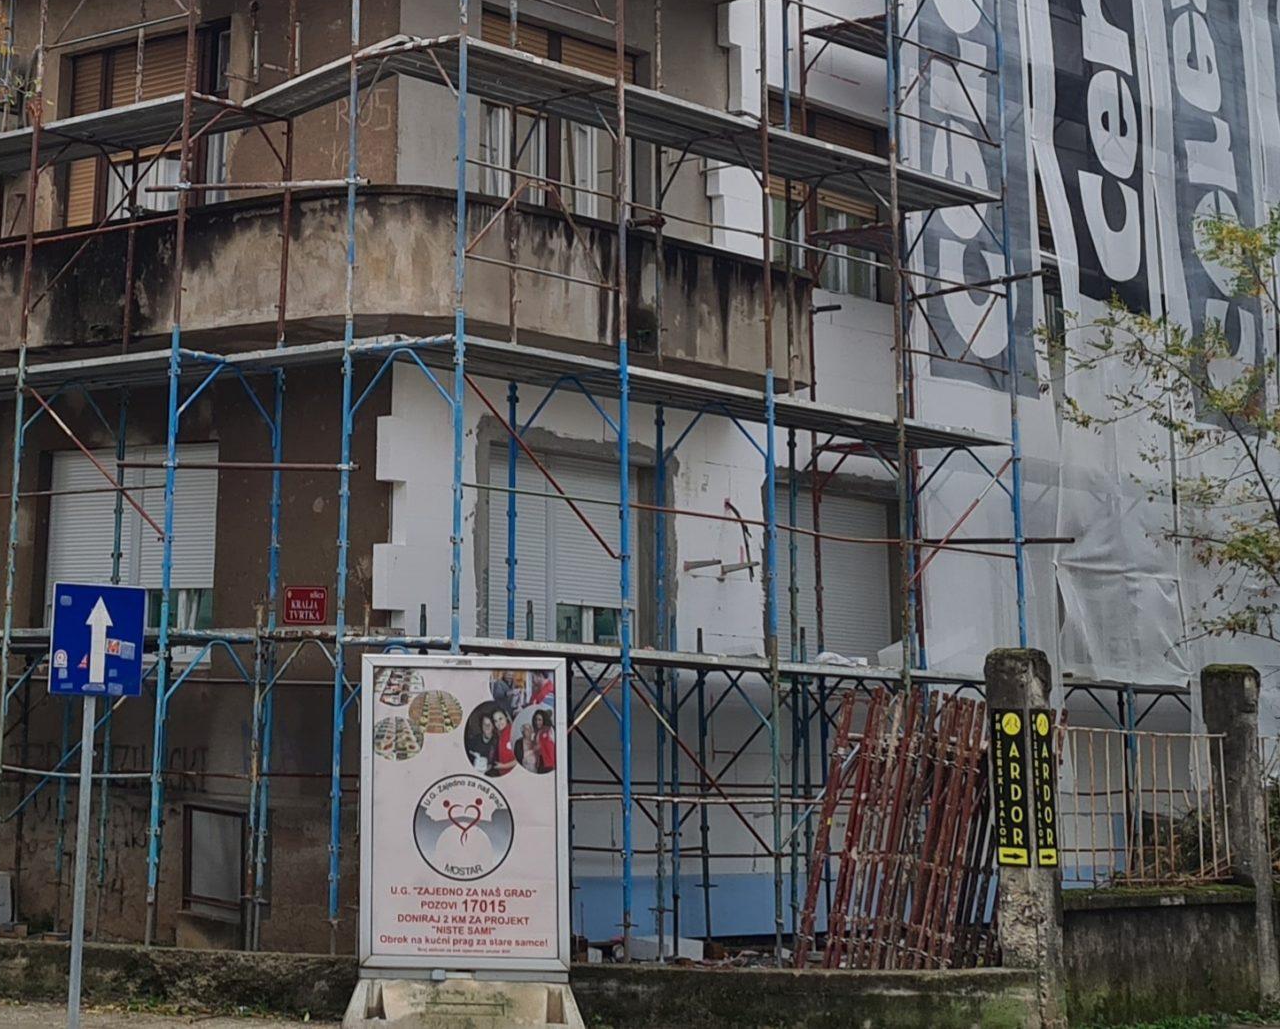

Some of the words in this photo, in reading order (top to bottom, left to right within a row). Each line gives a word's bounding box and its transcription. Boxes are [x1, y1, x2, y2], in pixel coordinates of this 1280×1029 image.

[291, 600, 319, 610] KRALJA
[1009, 741, 1023, 845] ARDOR
[1041, 742, 1054, 846] ARDOR
[999, 799, 1008, 845] SALON
[444, 863, 483, 876] MOSTAR
[390, 886, 411, 895] U.G.
[413, 886, 464, 896] "ZAJEDNO
[465, 888, 479, 897] ZA
[481, 886, 502, 897] NAŠ
[504, 888, 537, 898] GRAD"
[420, 900, 458, 910] POZOVI
[462, 898, 507, 913] 17015
[397, 913, 441, 923] DONIRAJ
[443, 914, 449, 923] 2
[451, 914, 466, 923] KM
[468, 915, 482, 924] ZA
[484, 915, 530, 925] PROJEKT
[431, 925, 464, 935] "NISTE
[467, 926, 496, 935] SAMI"
[379, 934, 408, 944] Obrok
[411, 936, 423, 944] na
[452, 937, 474, 947] prag
[476, 938, 486, 946] za
[489, 937, 512, 946] stare
[514, 938, 548, 947] samce!
